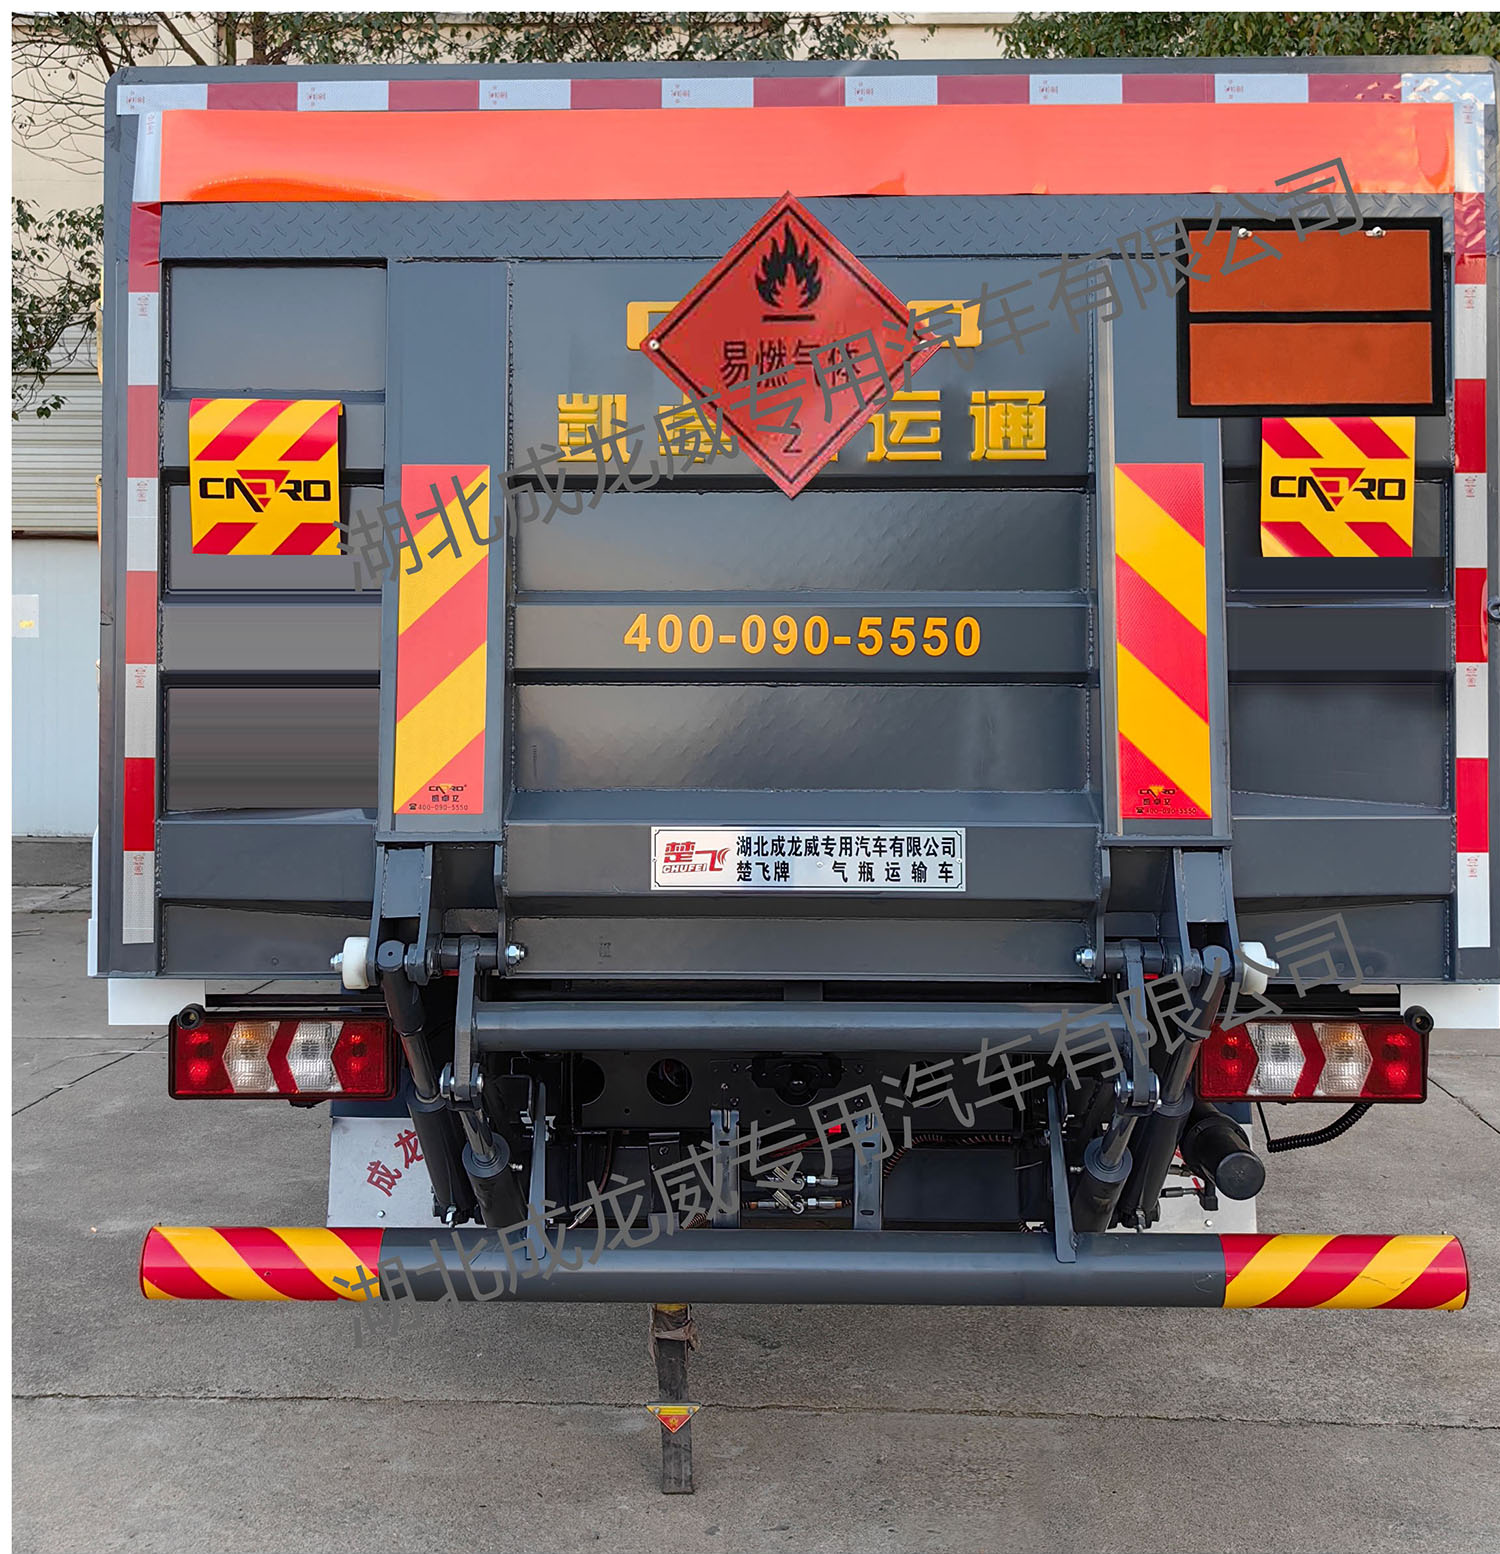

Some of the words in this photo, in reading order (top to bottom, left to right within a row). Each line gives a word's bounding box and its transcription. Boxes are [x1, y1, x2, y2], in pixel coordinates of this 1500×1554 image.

[720, 339, 860, 388] 易燃气体
[782, 421, 803, 454] 2
[623, 613, 982, 656] 400-090-5550
[735, 835, 957, 858] 湖北成龙威专用汽车有限公司
[661, 863, 708, 874] CHUFEI
[735, 860, 791, 883] 楚飞牌
[831, 860, 955, 884] 气瓶运输车
